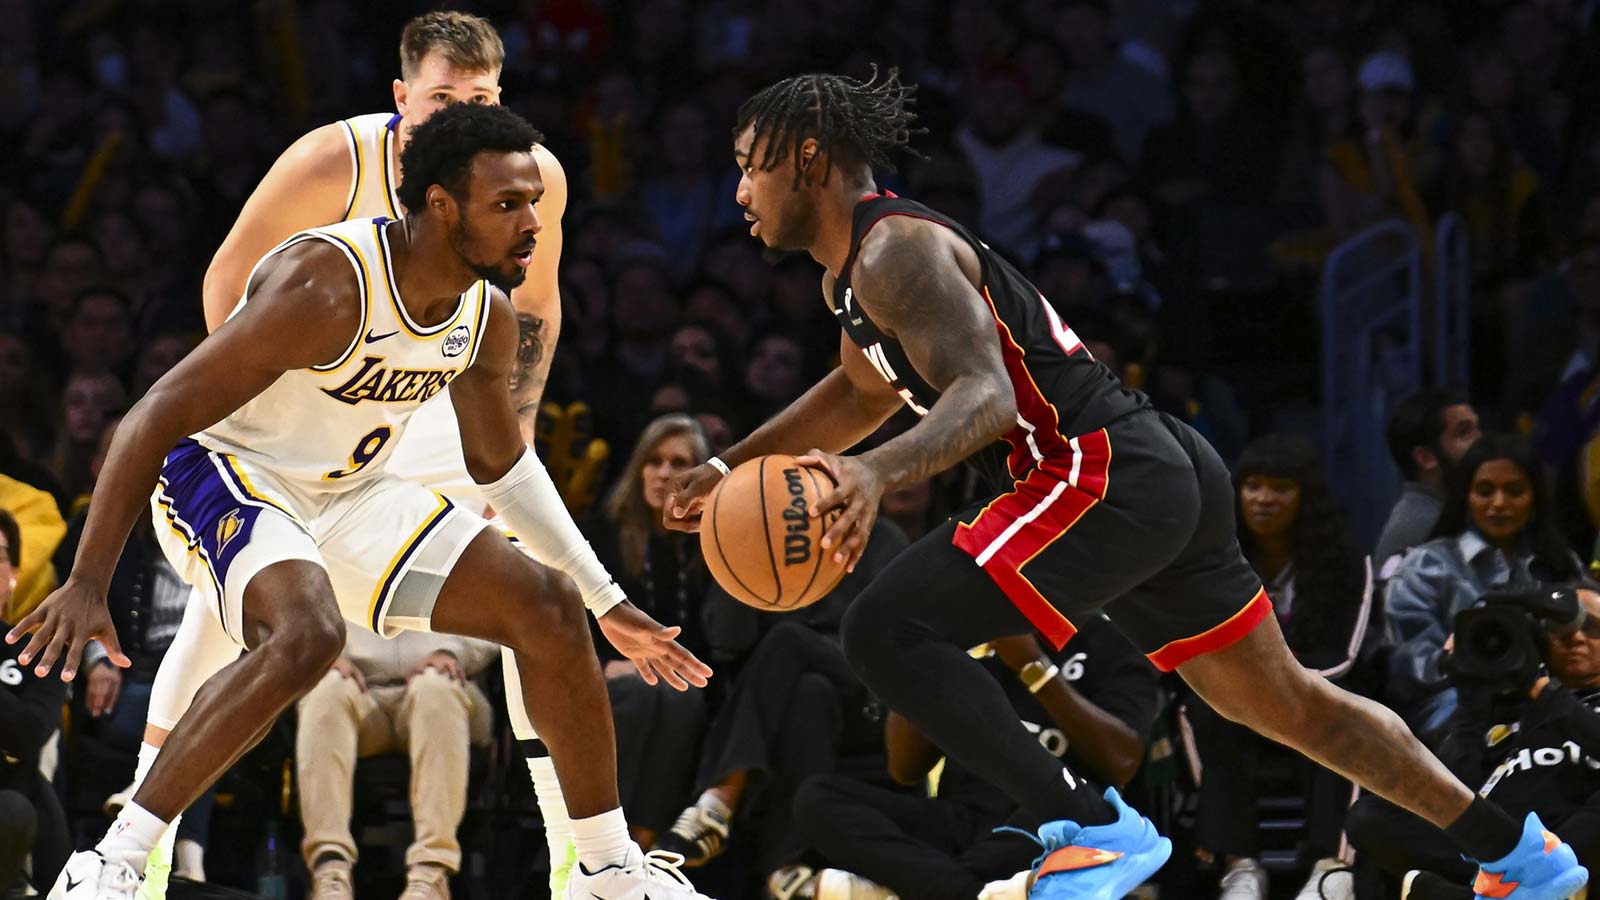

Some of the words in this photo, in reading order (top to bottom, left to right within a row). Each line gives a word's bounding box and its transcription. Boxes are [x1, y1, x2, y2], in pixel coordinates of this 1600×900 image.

[445, 333, 469, 348] bibigo
[318, 354, 459, 406] LAKERS
[322, 424, 393, 481] 9
[782, 467, 812, 568] Wilson
[0, 658, 23, 686] 6
[1061, 652, 1089, 681] 6
